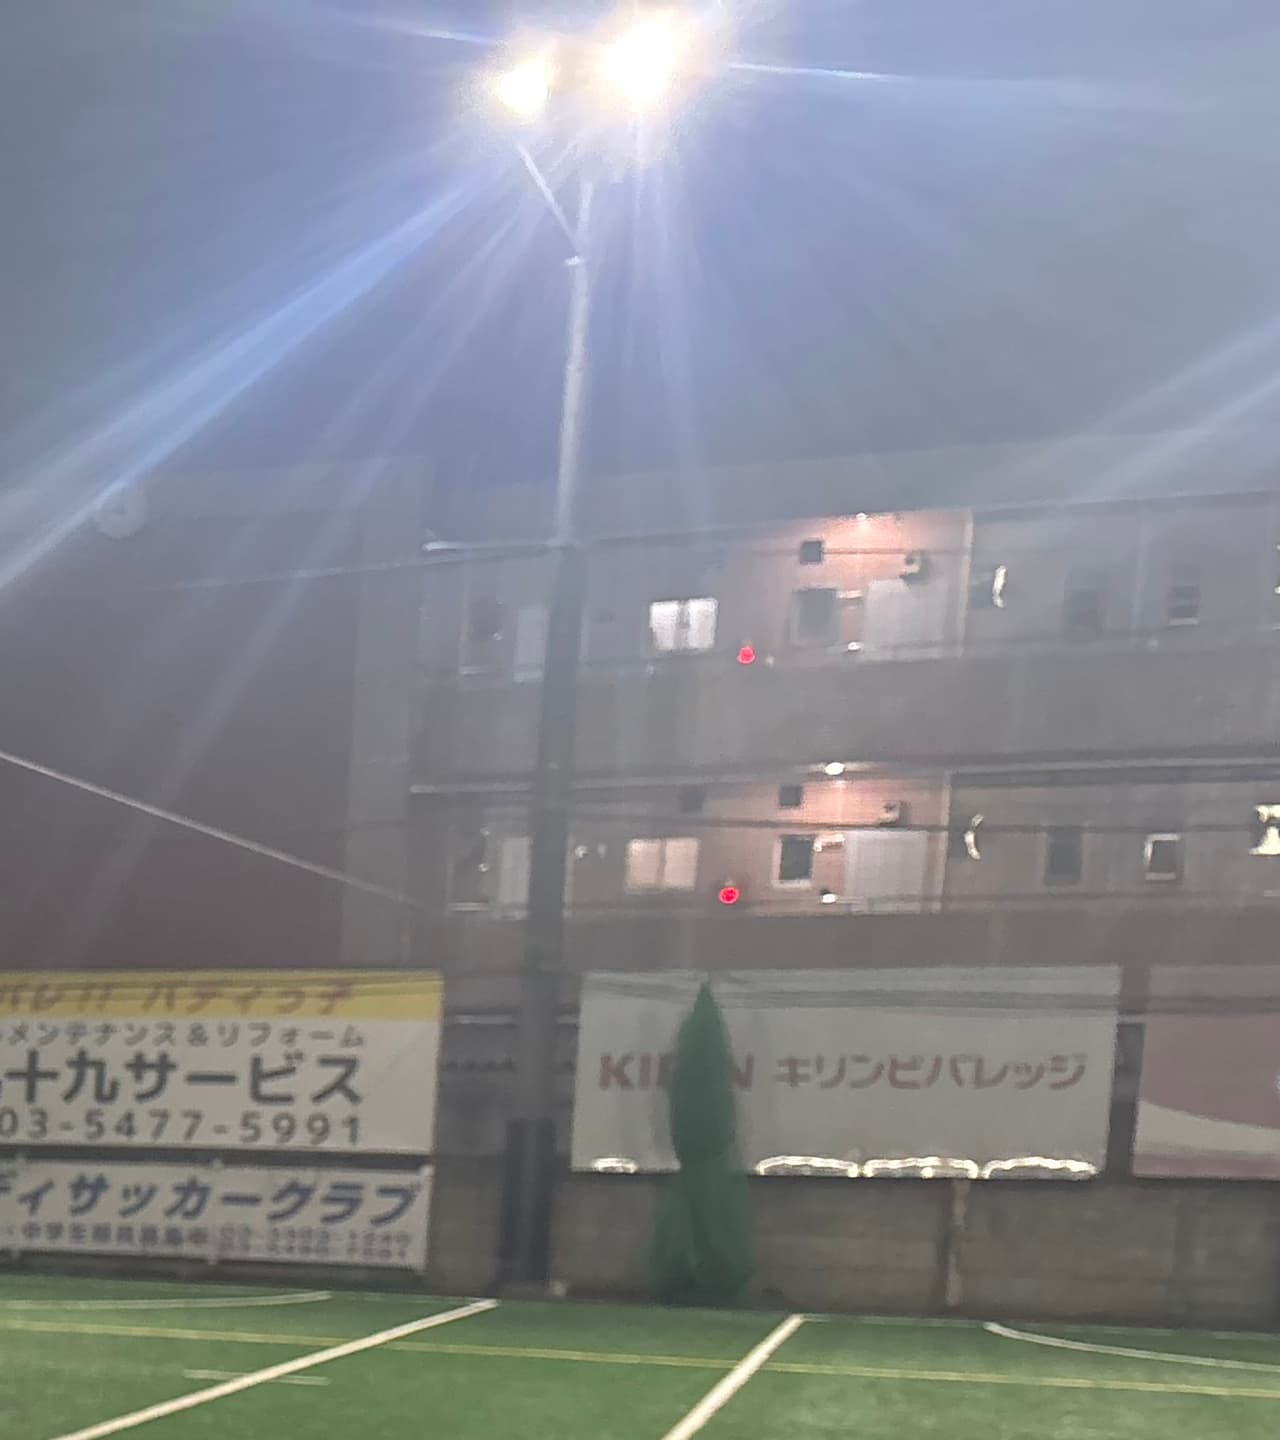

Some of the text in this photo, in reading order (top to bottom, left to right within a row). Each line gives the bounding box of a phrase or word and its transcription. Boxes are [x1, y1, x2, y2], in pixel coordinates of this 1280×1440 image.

[774, 1053, 1089, 1091] キリンビバレッジ
